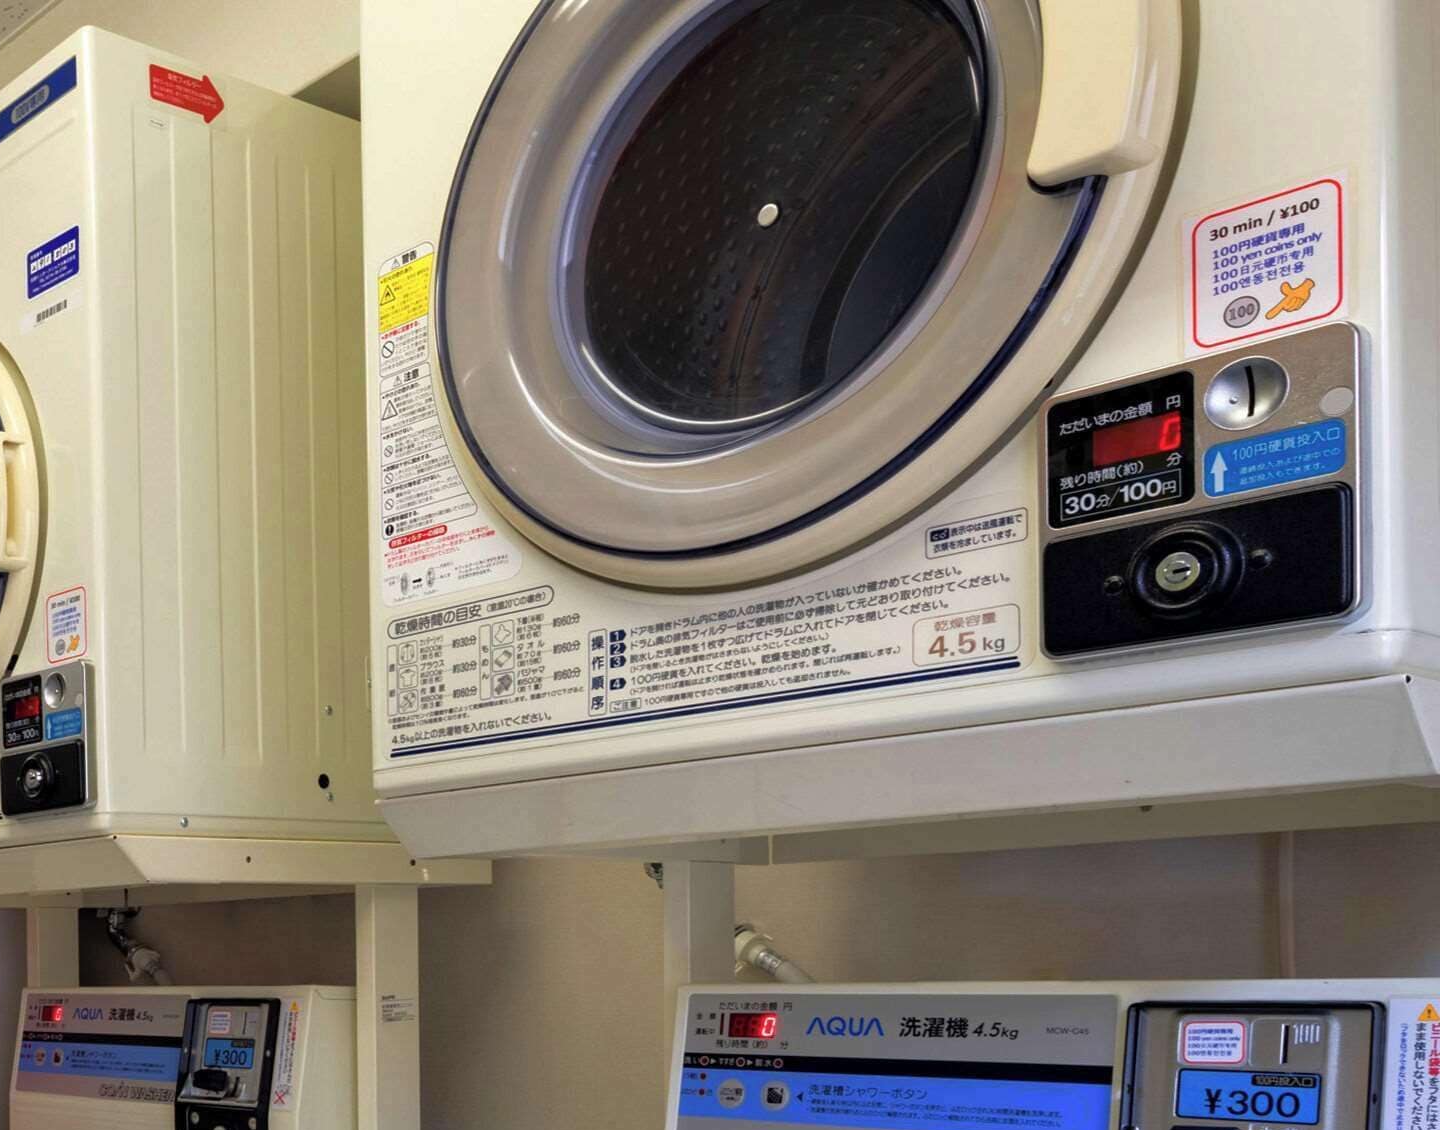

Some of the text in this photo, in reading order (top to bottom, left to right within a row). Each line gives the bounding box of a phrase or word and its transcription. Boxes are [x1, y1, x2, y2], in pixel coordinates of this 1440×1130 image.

[1210, 198, 1320, 241] 30 min / ¥100
[1213, 223, 1305, 259] 100円硬貨専用
[1213, 232, 1322, 270] 100 yen coins only
[1213, 246, 1314, 283] 100日元硬币专用
[1213, 261, 1304, 296] 100엔동전전용
[1229, 303, 1255, 321] 100
[403, 368, 420, 382] 注意
[1060, 394, 1181, 436] ただいまの金額 円
[1232, 427, 1340, 460] 100円硬貨投入口
[1167, 452, 1182, 468] 分
[1064, 479, 1177, 515] 30分/100円
[394, 604, 482, 634] 乾燥時間の目安
[934, 612, 997, 632] 乾燥容量
[614, 631, 620, 641] 1
[928, 631, 1006, 658] 4.5 kg
[613, 643, 621, 654] 2
[613, 658, 621, 668] 3
[613, 678, 621, 689] 4
[72, 1007, 154, 1022] AQUA 洗濯機 4.5kg
[719, 1002, 793, 1011] ただいまの金額 円
[761, 1016, 776, 1037] 0
[806, 1016, 884, 1036] AQUA
[899, 1016, 969, 1039] 洗濯機
[972, 1021, 1019, 1040] 4.5kg
[214, 1049, 247, 1066] ¥300
[809, 1083, 928, 1100] 洗濯槽シャワーボタン
[1204, 1088, 1300, 1118] ¥300
